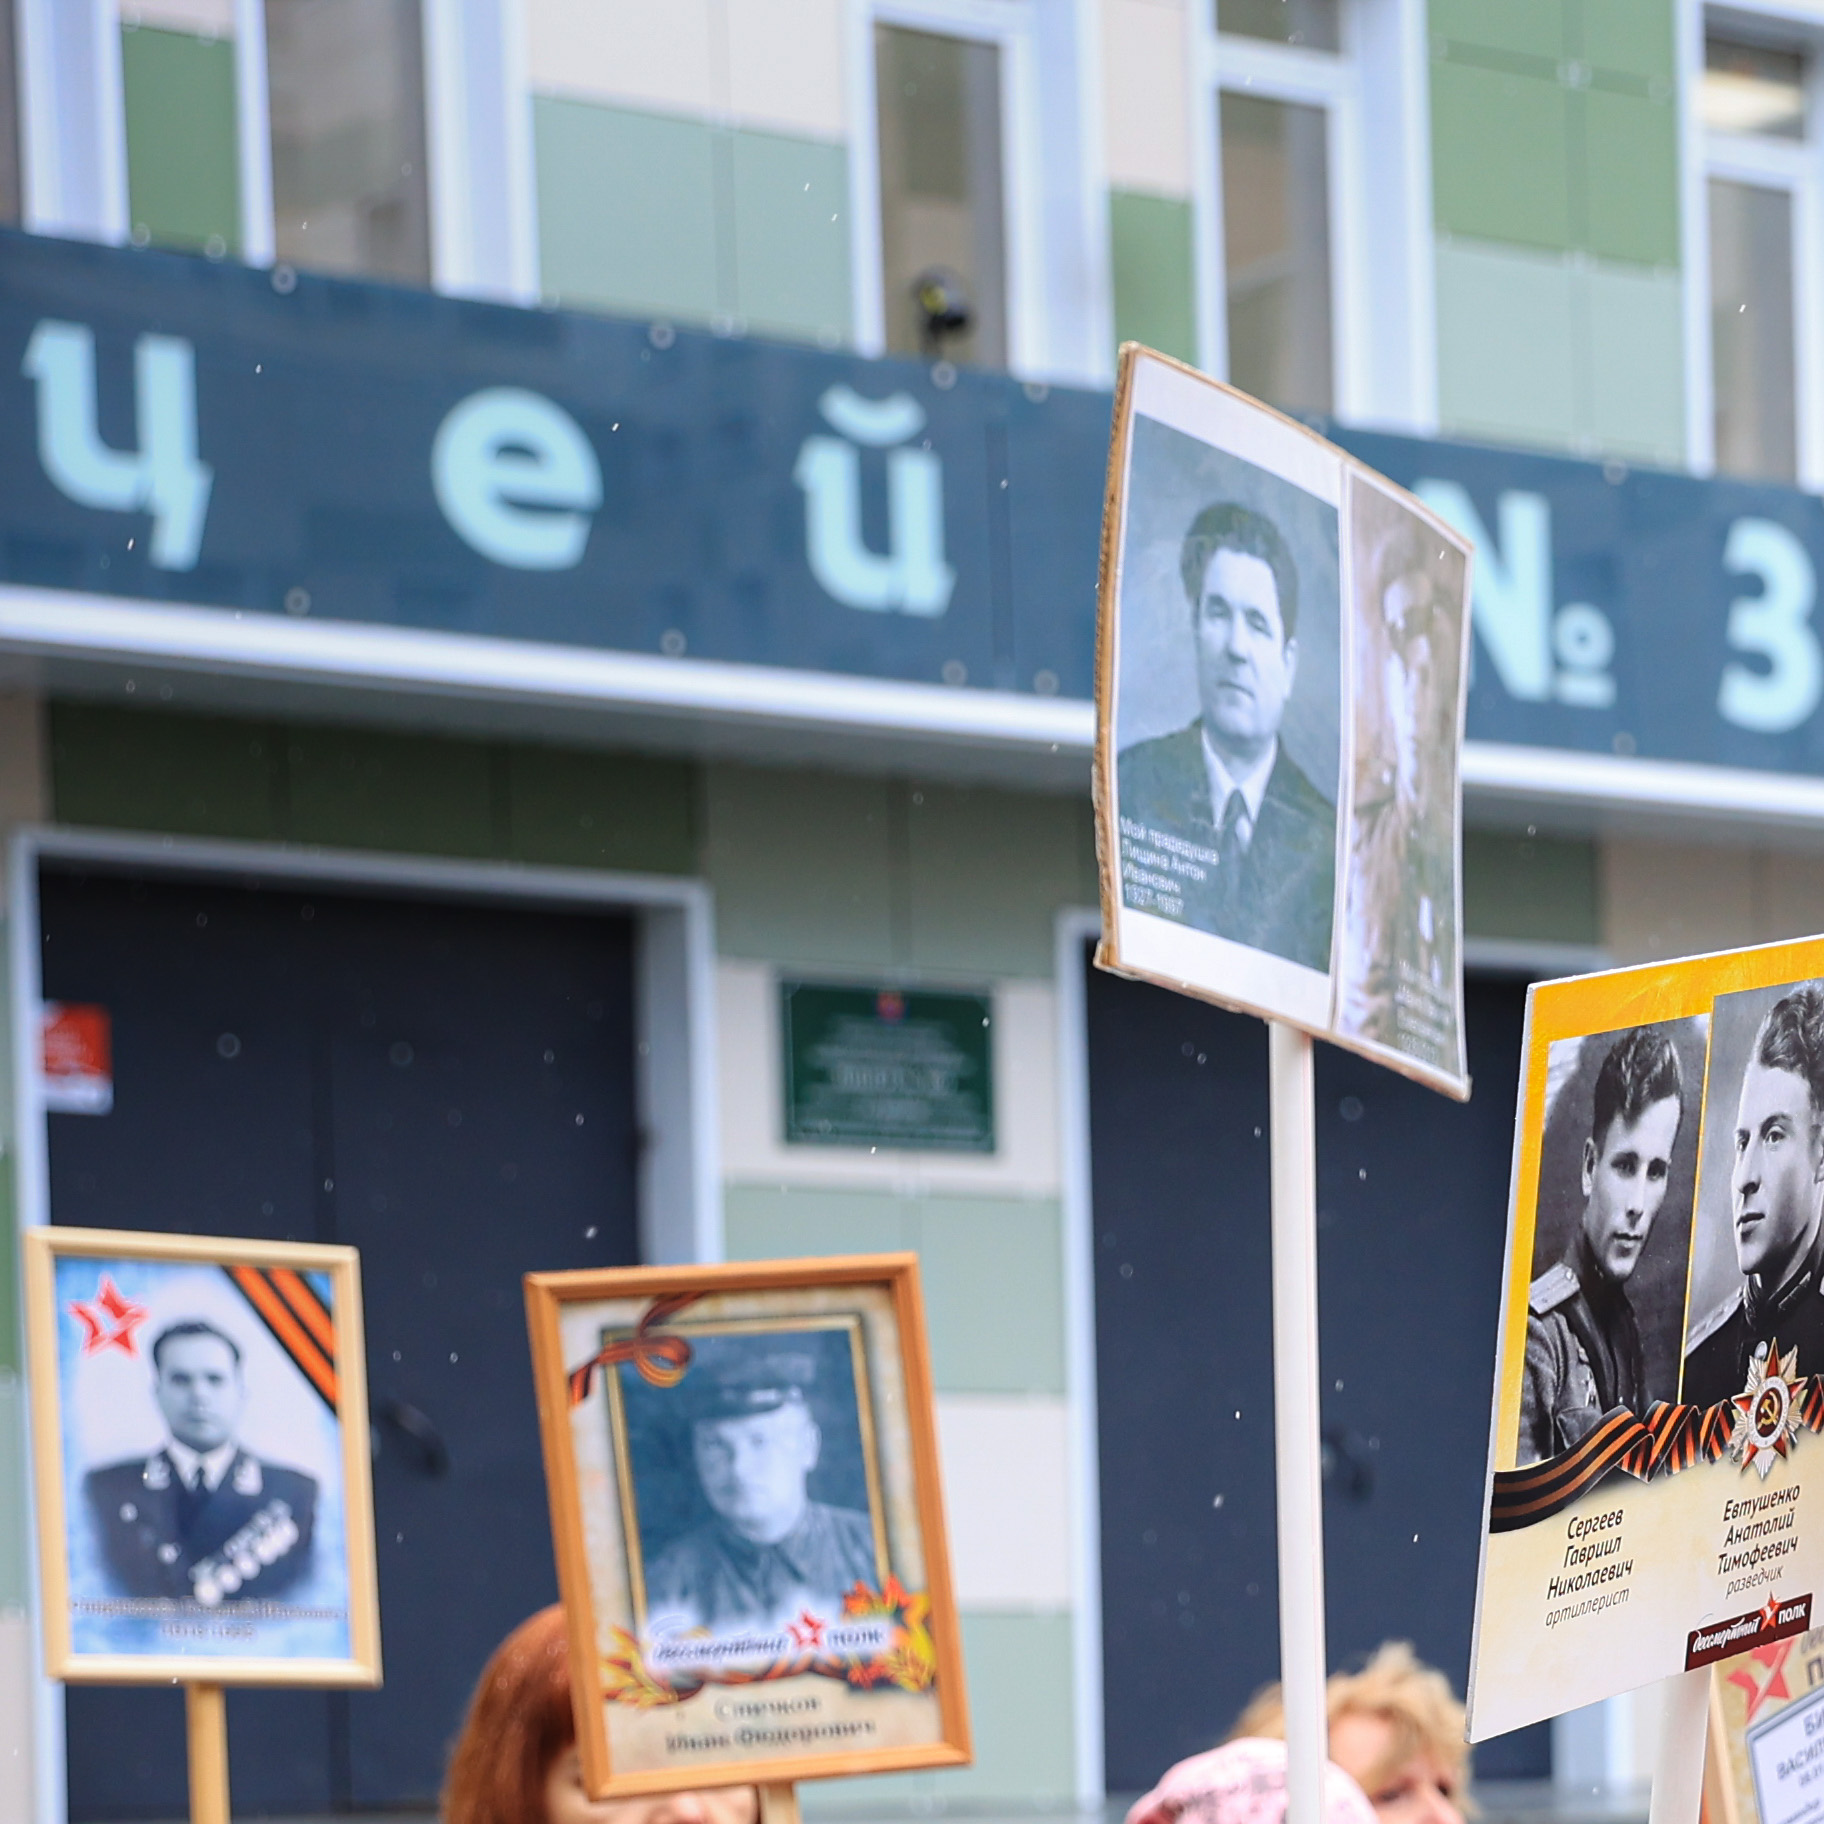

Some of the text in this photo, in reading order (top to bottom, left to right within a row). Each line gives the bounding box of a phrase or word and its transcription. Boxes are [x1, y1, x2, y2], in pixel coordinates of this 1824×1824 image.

[1722, 1484, 1801, 1522] Евтушенко
[1567, 1508, 1624, 1540] Сергеев
[1723, 1507, 1796, 1548] Анатолий
[1563, 1535, 1622, 1569] Гавриил
[1716, 1535, 1799, 1576] Тимофеевич
[1547, 1558, 1634, 1601] Николаевич
[1725, 1564, 1784, 1599] разведчик
[1545, 1586, 1630, 1629] артиллерист
